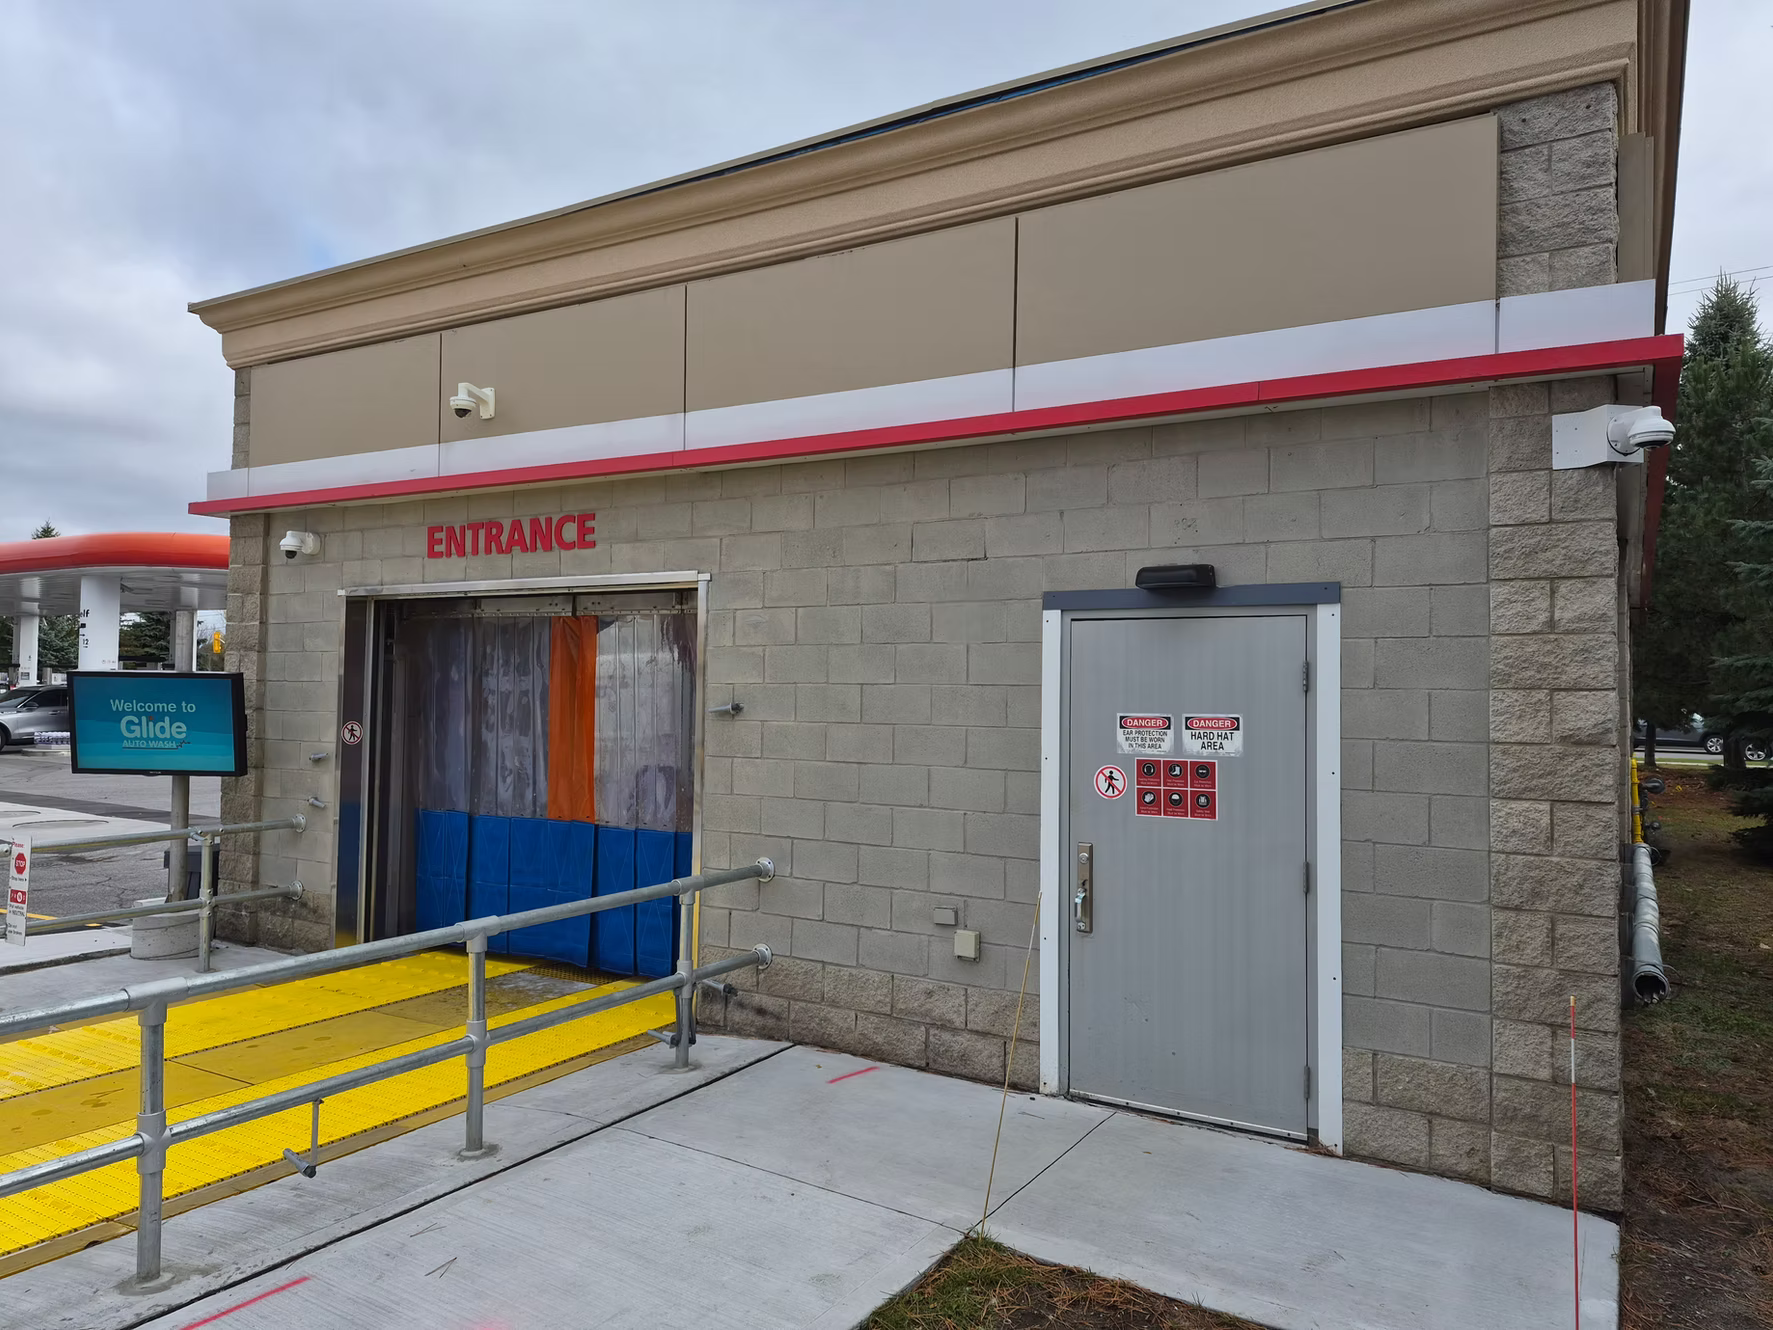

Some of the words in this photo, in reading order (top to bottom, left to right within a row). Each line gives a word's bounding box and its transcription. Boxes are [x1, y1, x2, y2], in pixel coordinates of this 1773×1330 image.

[427, 512, 596, 558] ENTRANCE
[110, 699, 177, 712] Welcome
[181, 701, 196, 713] to
[120, 715, 187, 739] Glide
[1126, 719, 1163, 727] DANGER
[1192, 719, 1231, 728] DANGER
[1190, 731, 1215, 740] HARD
[1217, 732, 1234, 741] HAT
[122, 740, 147, 748] AUTO
[148, 740, 177, 748] WASH
[1200, 741, 1224, 751] AREA
